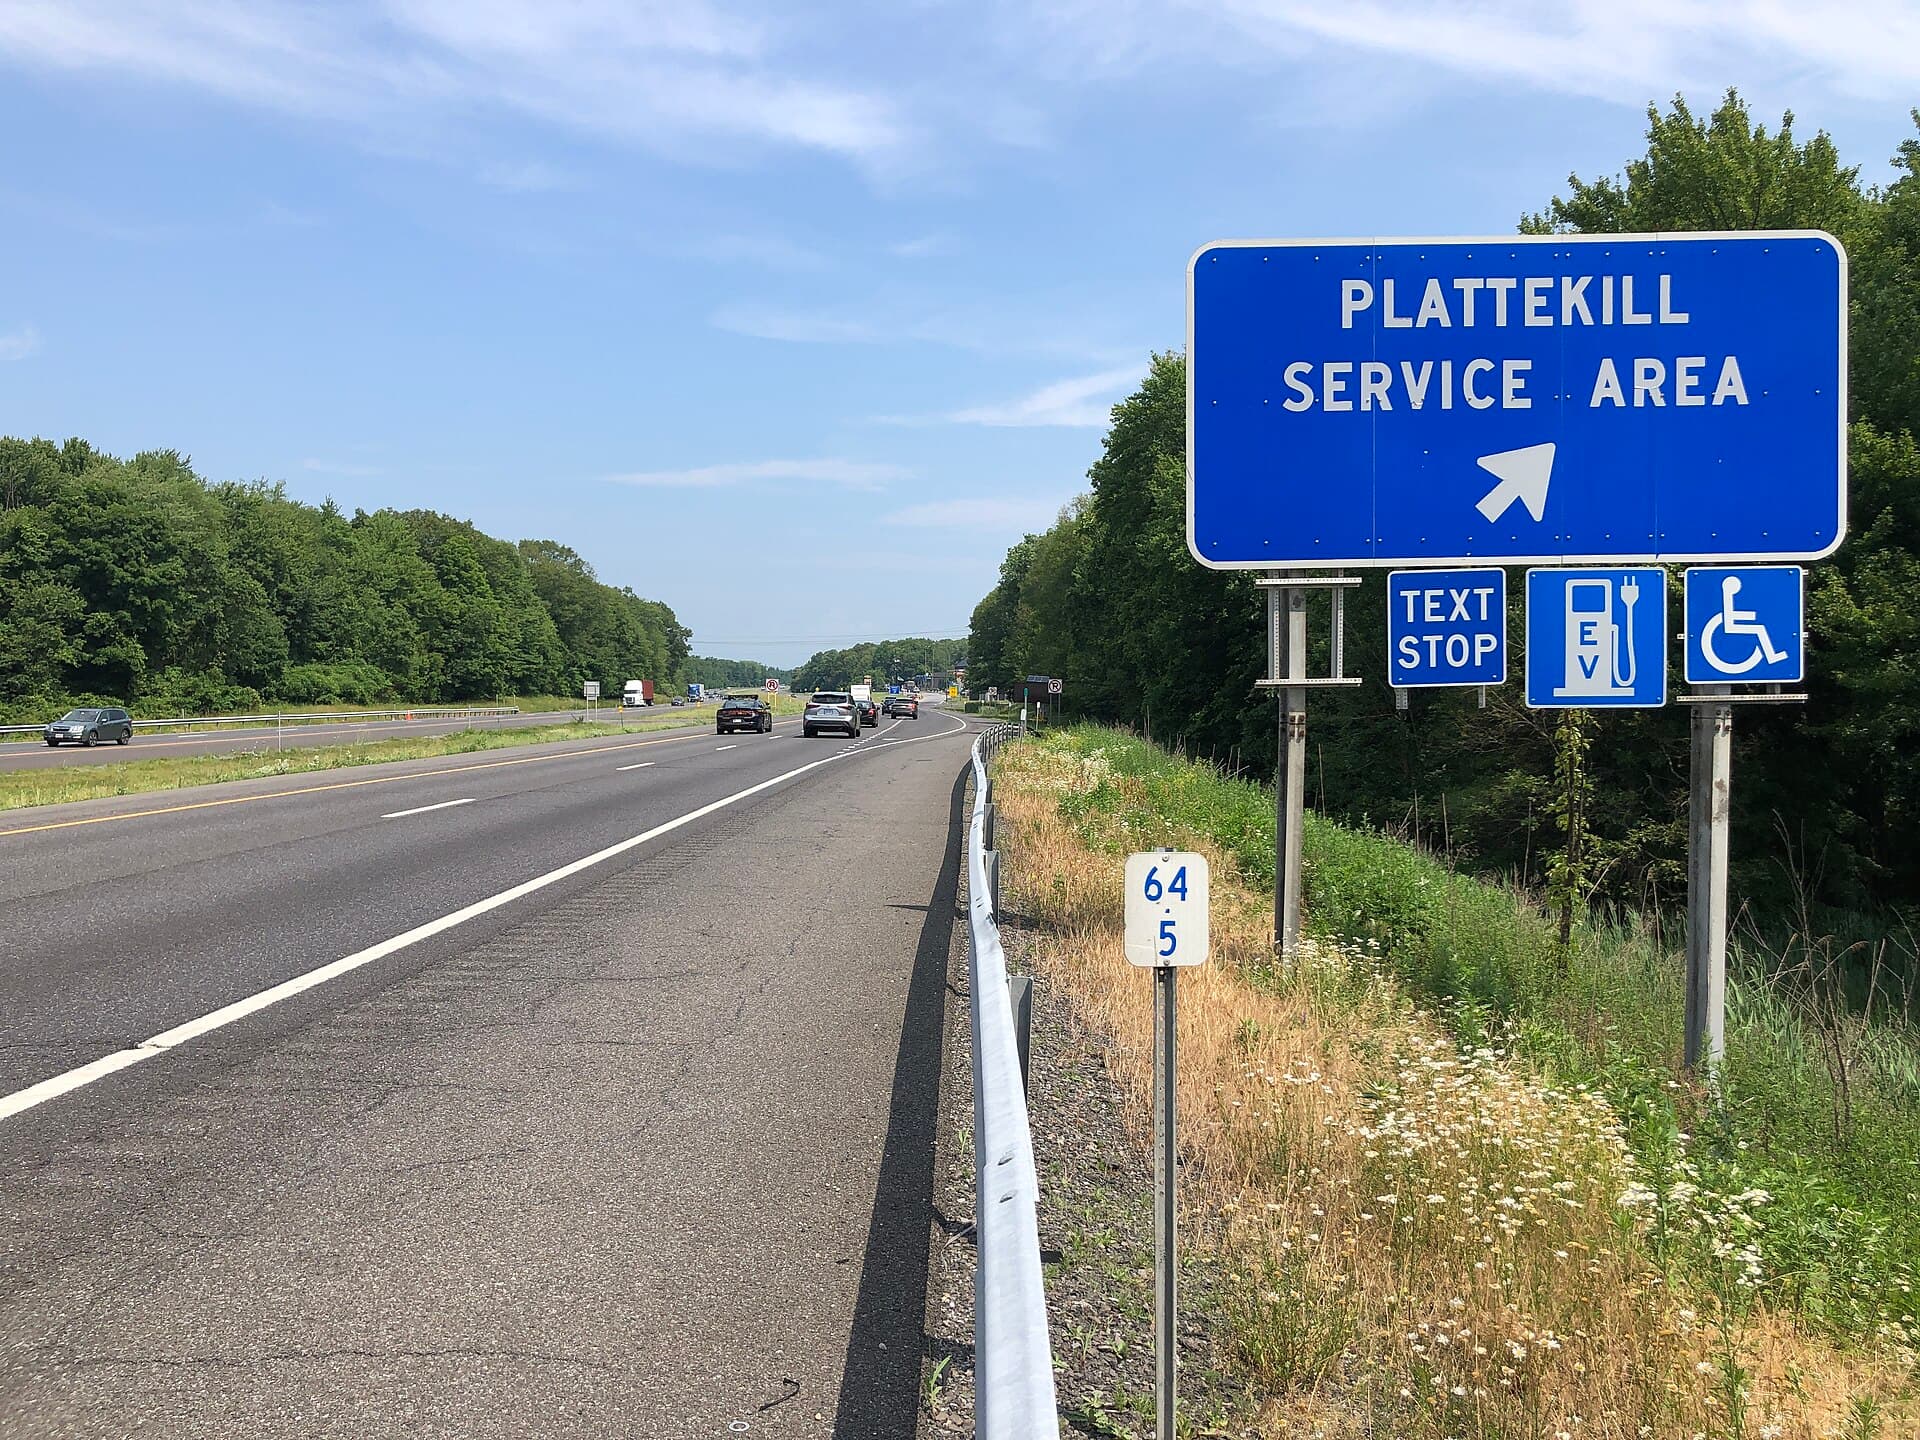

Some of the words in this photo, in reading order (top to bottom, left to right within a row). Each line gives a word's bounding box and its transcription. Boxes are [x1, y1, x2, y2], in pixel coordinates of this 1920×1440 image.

[1341, 274, 1690, 329] PLATTEKILL
[1282, 358, 1532, 412] SERVICE
[1589, 356, 1749, 408] AREA
[1400, 587, 1495, 623] TEXT
[1398, 633, 1498, 669] STOP
[1144, 866, 1188, 902] 64
[1158, 920, 1177, 957] 5
